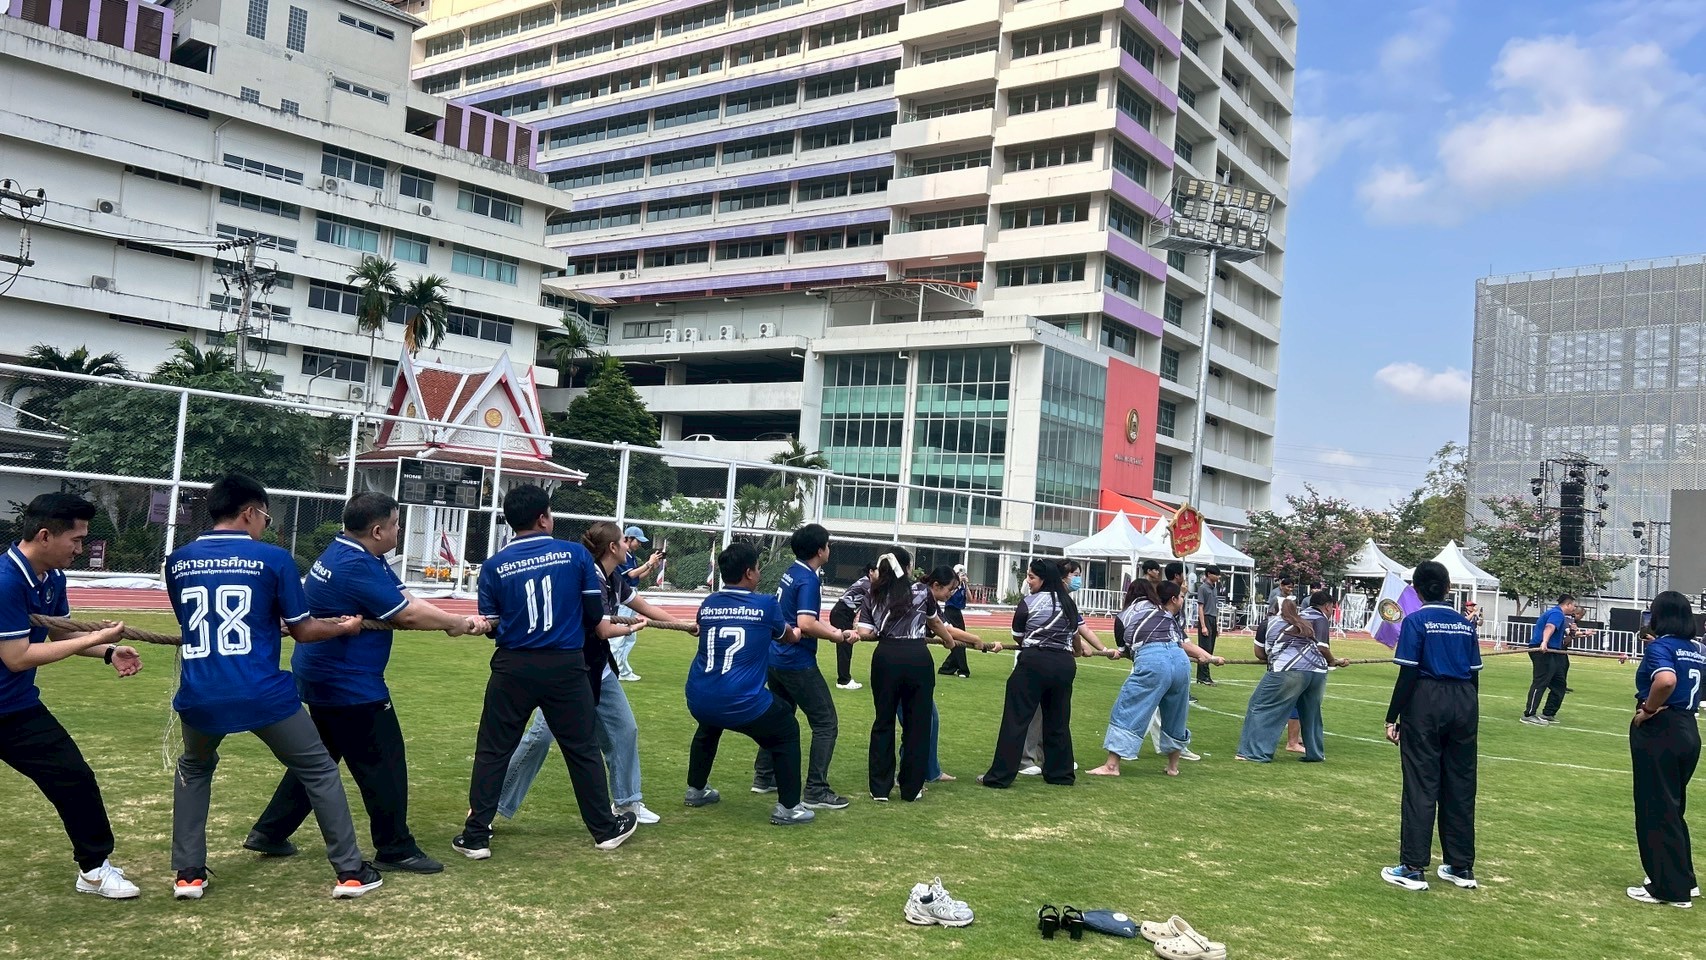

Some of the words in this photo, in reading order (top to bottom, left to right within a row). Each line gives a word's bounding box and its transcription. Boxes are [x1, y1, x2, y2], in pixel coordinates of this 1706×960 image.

[171, 556, 264, 575] บริหารการศึกษา
[496, 551, 572, 574] บริหารการศึกษา
[525, 574, 553, 634] 11
[700, 605, 764, 617] บริหารการศึกษา
[181, 585, 253, 660] 38
[704, 626, 746, 675] 17
